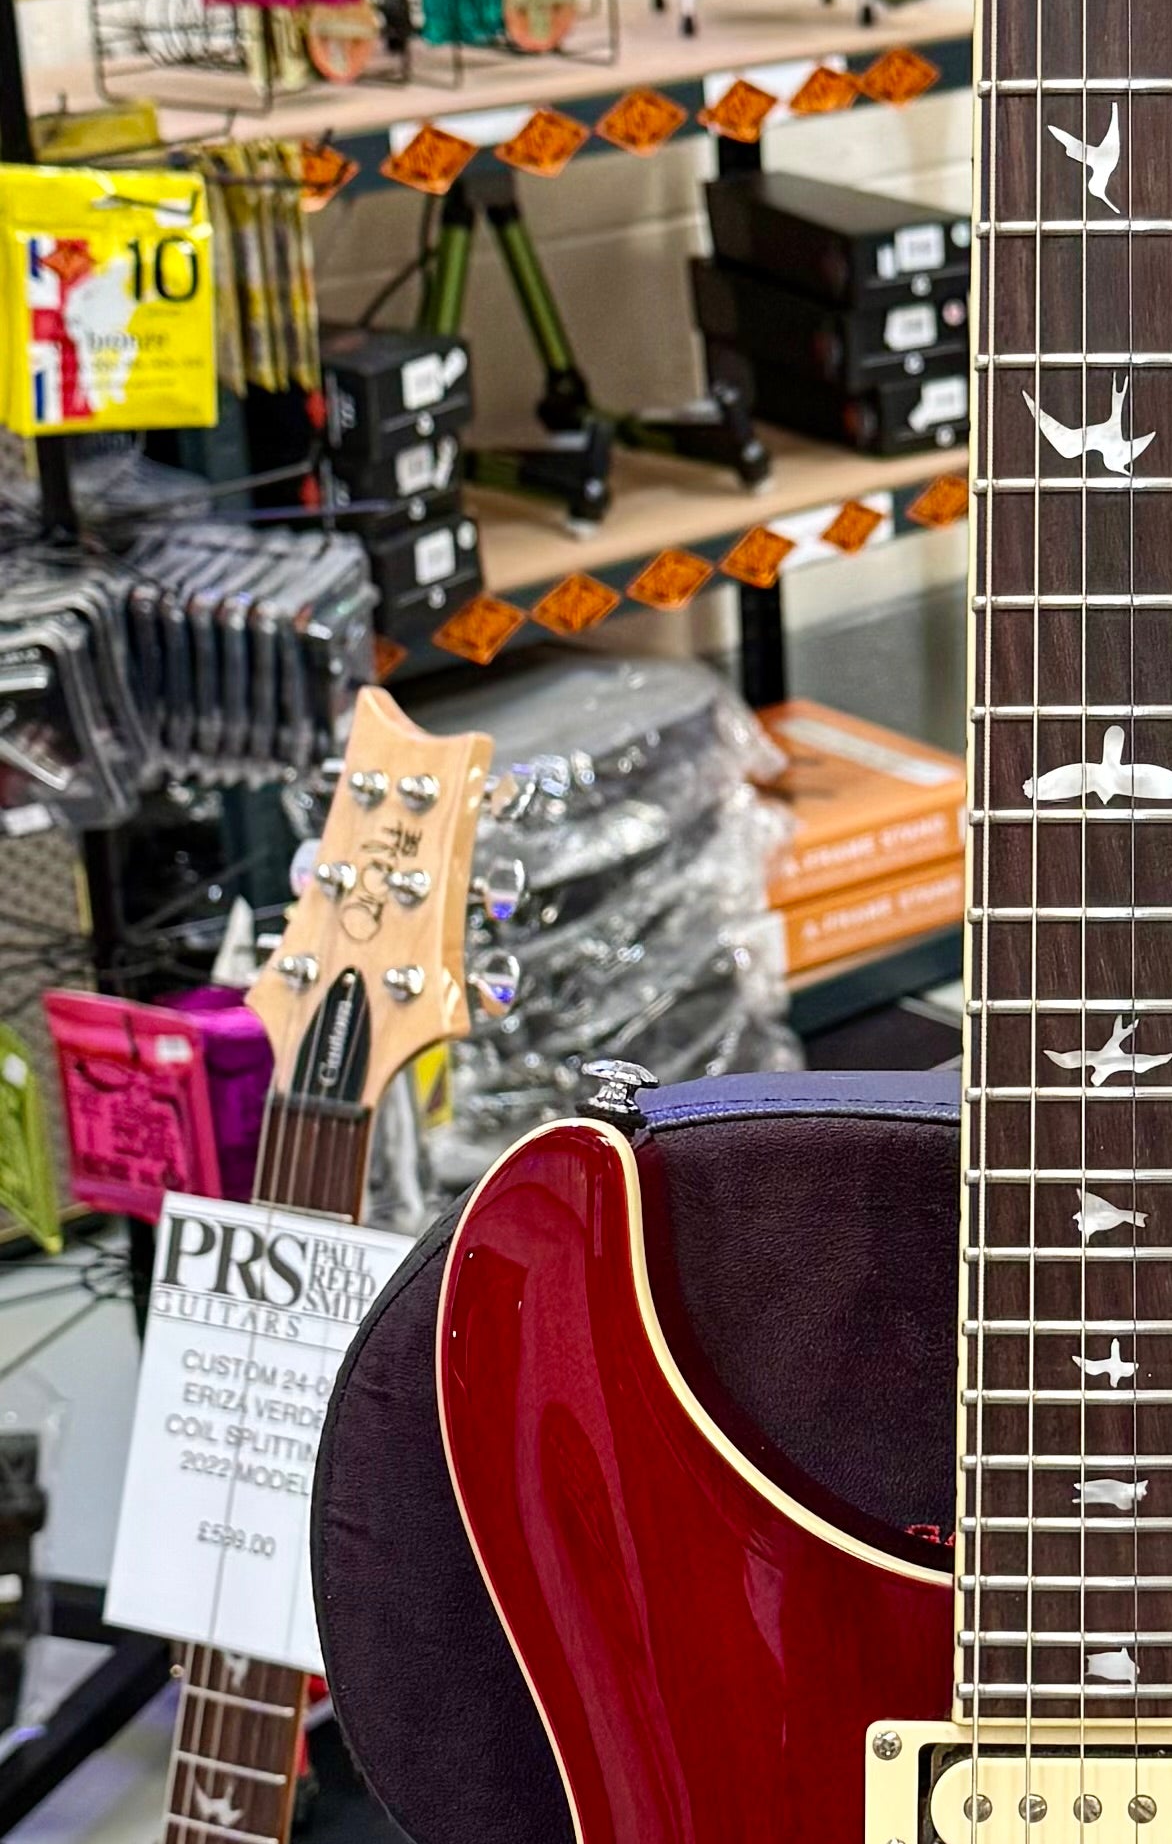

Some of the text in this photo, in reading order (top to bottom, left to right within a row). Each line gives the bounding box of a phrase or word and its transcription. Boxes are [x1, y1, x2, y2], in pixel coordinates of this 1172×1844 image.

[127, 235, 200, 303] 10
[156, 1212, 308, 1307] PRS
[308, 1256, 377, 1301] REED
[310, 1237, 372, 1275] PAUL
[154, 1288, 303, 1339] GUITARS
[182, 1348, 278, 1387] CUSTOM
[182, 1382, 249, 1415] ERIZA
[165, 1413, 218, 1443] COIL
[179, 1448, 310, 1497] 2022 MODEL
